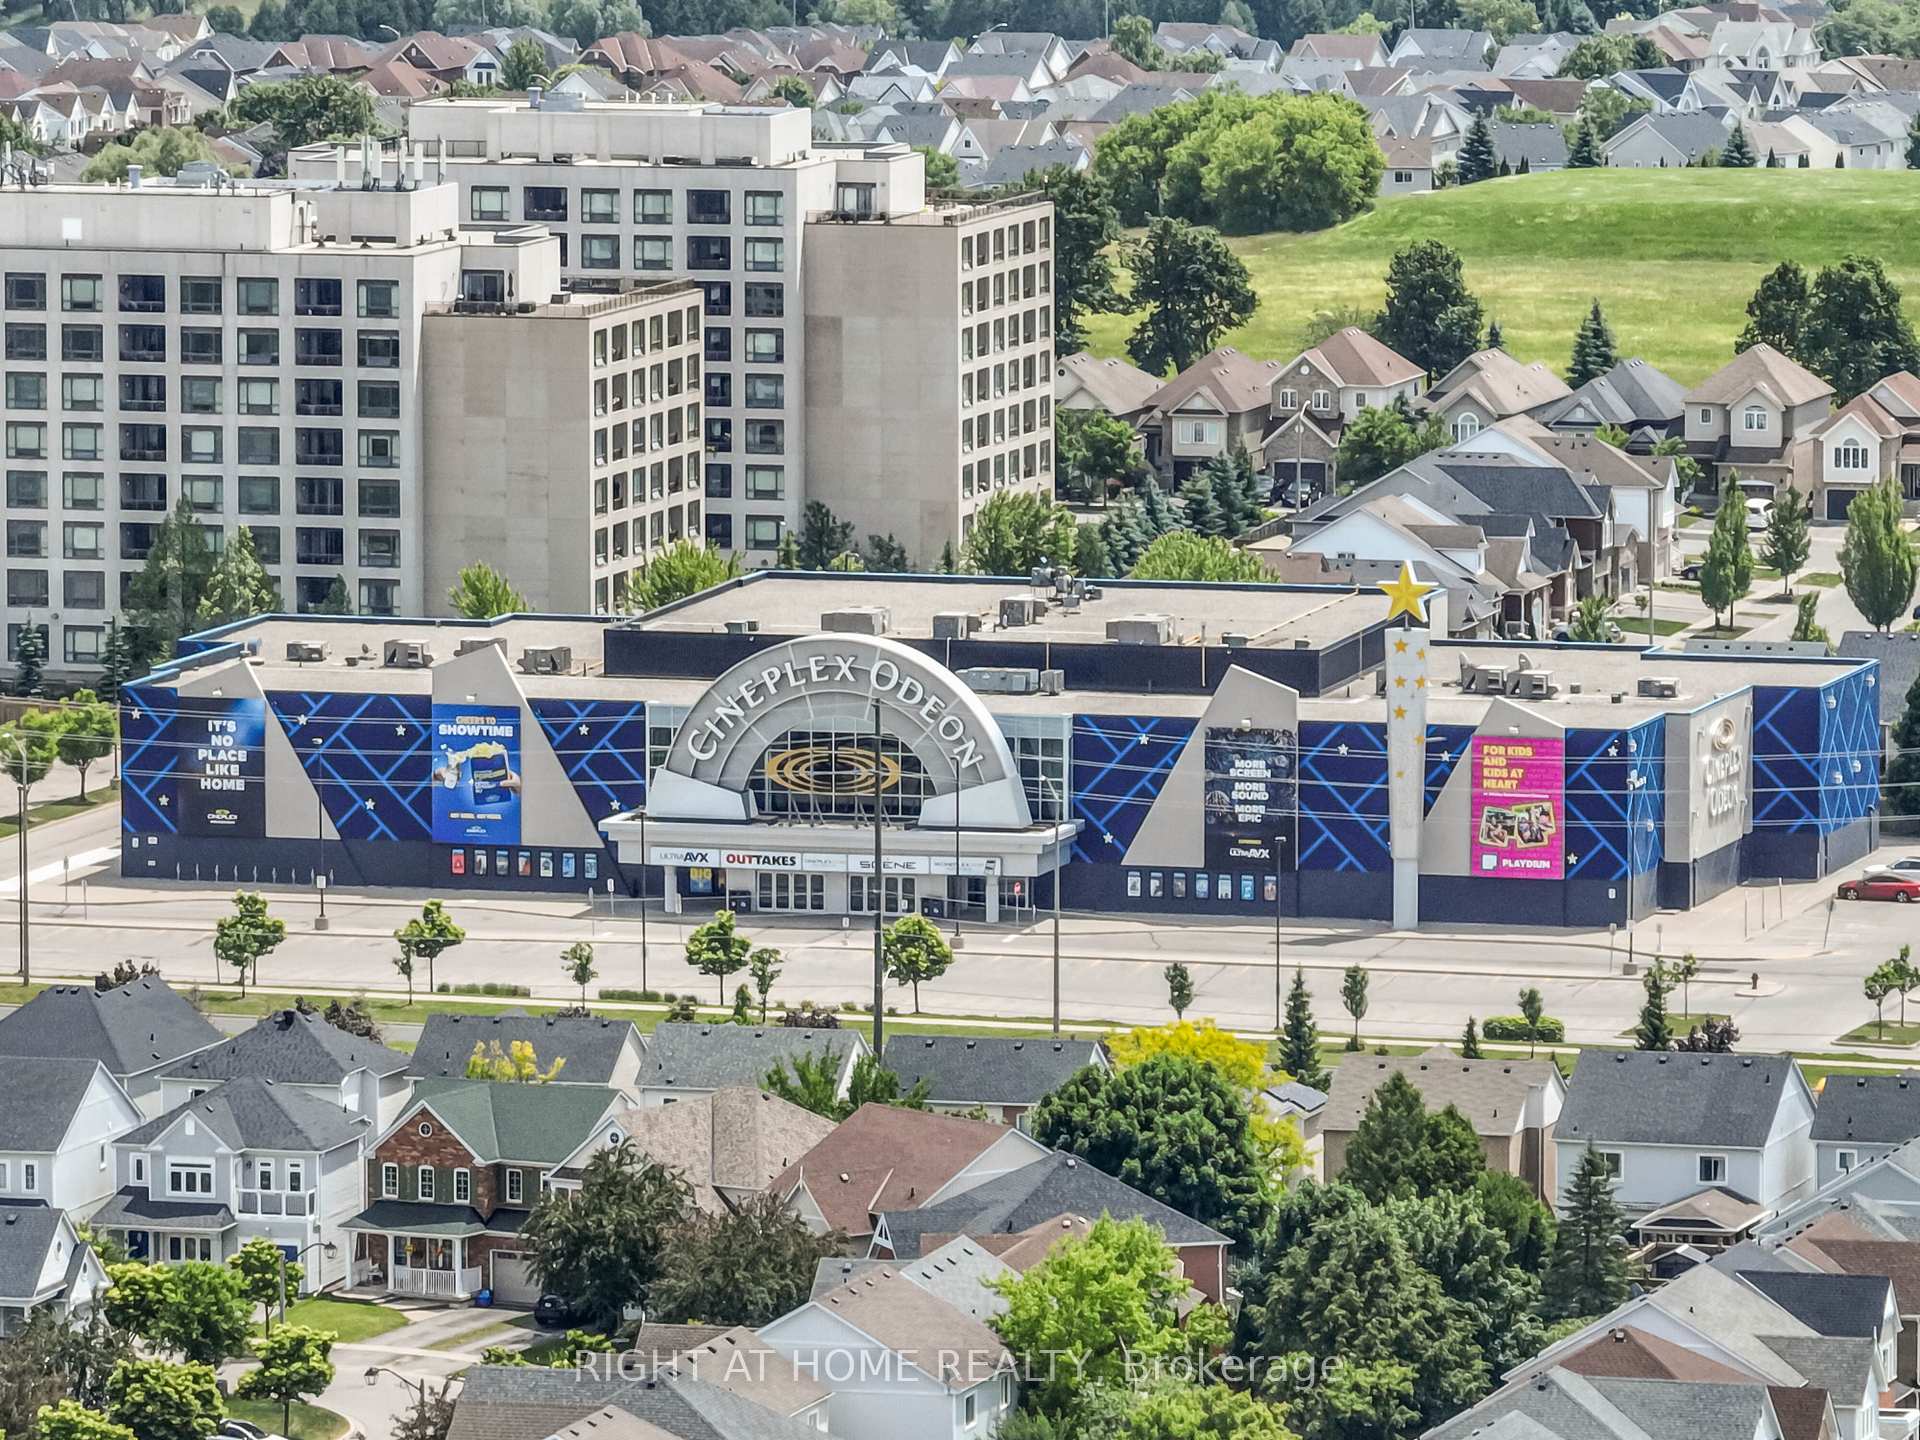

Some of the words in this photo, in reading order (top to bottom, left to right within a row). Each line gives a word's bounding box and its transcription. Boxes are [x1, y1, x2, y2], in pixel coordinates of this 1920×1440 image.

[688, 655, 856, 761] CINEPLEX
[870, 660, 984, 769] ODEON
[207, 719, 237, 733] IT'S
[438, 723, 514, 738] SHOWTIME
[211, 734, 234, 747] NO
[198, 747, 248, 762] PLACE
[1483, 744, 1506, 755] FOR
[1506, 745, 1533, 757] KIDS
[1234, 759, 1267, 769] MORE
[1483, 756, 1507, 767] AND
[205, 763, 240, 776] LIKE
[1229, 768, 1272, 779] SCREEN
[1483, 767, 1508, 778] KIDS
[1510, 768, 1524, 779] AT
[200, 778, 246, 792] HOME
[1234, 782, 1267, 791] MORE
[1483, 778, 1518, 790] HEART
[1231, 790, 1270, 801] SOUND
[1234, 804, 1267, 814] MORE
[1237, 813, 1263, 824] EPIC
[726, 853, 797, 866] OUTTAKES
[1501, 858, 1551, 869] PLAYDIUM
